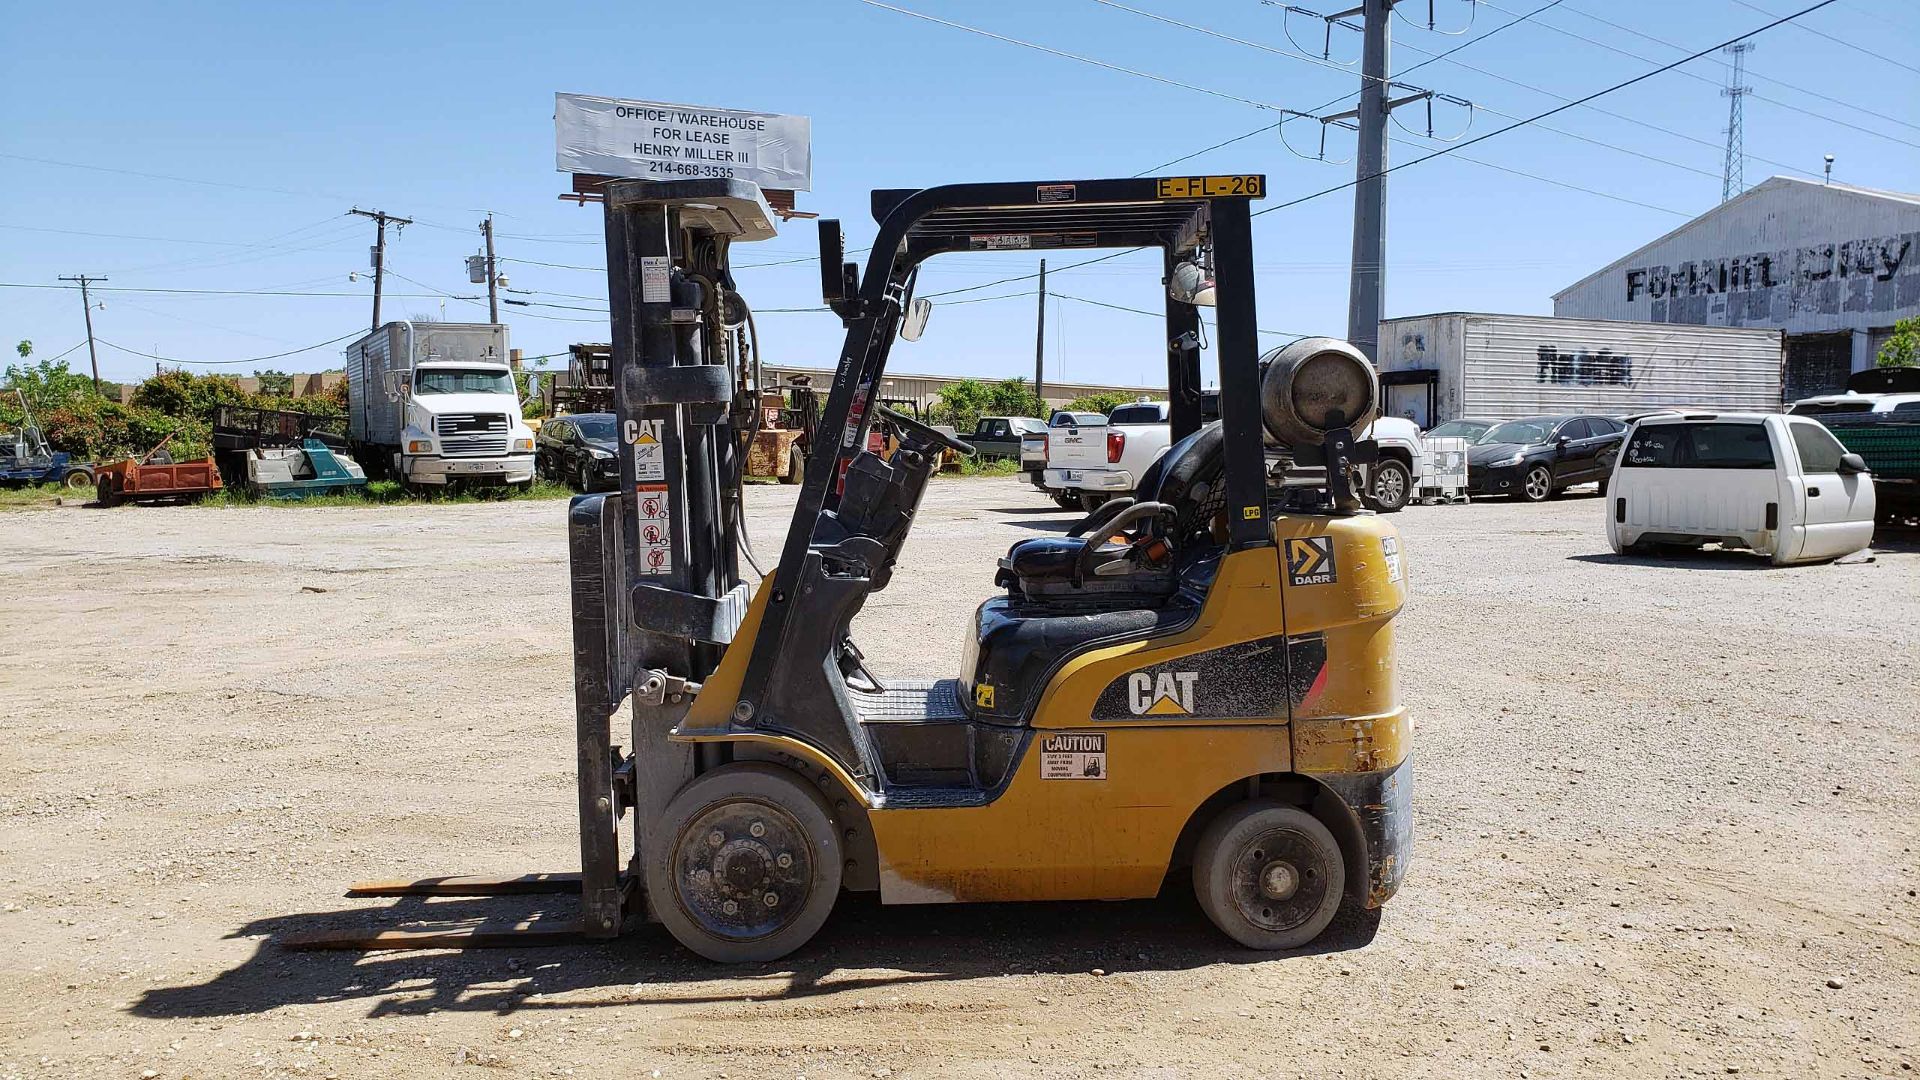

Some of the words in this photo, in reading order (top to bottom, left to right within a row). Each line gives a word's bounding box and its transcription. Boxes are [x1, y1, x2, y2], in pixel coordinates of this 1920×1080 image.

[615, 106, 667, 122] OFFICE
[670, 112, 675, 123] /
[677, 113, 766, 131] WAREHOUSE
[653, 127, 682, 141] FOR
[686, 130, 730, 145] LEASE
[633, 142, 681, 158] HENRY
[684, 147, 734, 162] MILLER
[738, 152, 749, 163] III
[649, 161, 735, 179] 214-668-3535
[623, 419, 665, 445] CAT
[1244, 508, 1260, 517] LPG
[1294, 574, 1331, 585] DARR
[1128, 671, 1199, 715] CAT
[1046, 736, 1102, 751] CAUTION
